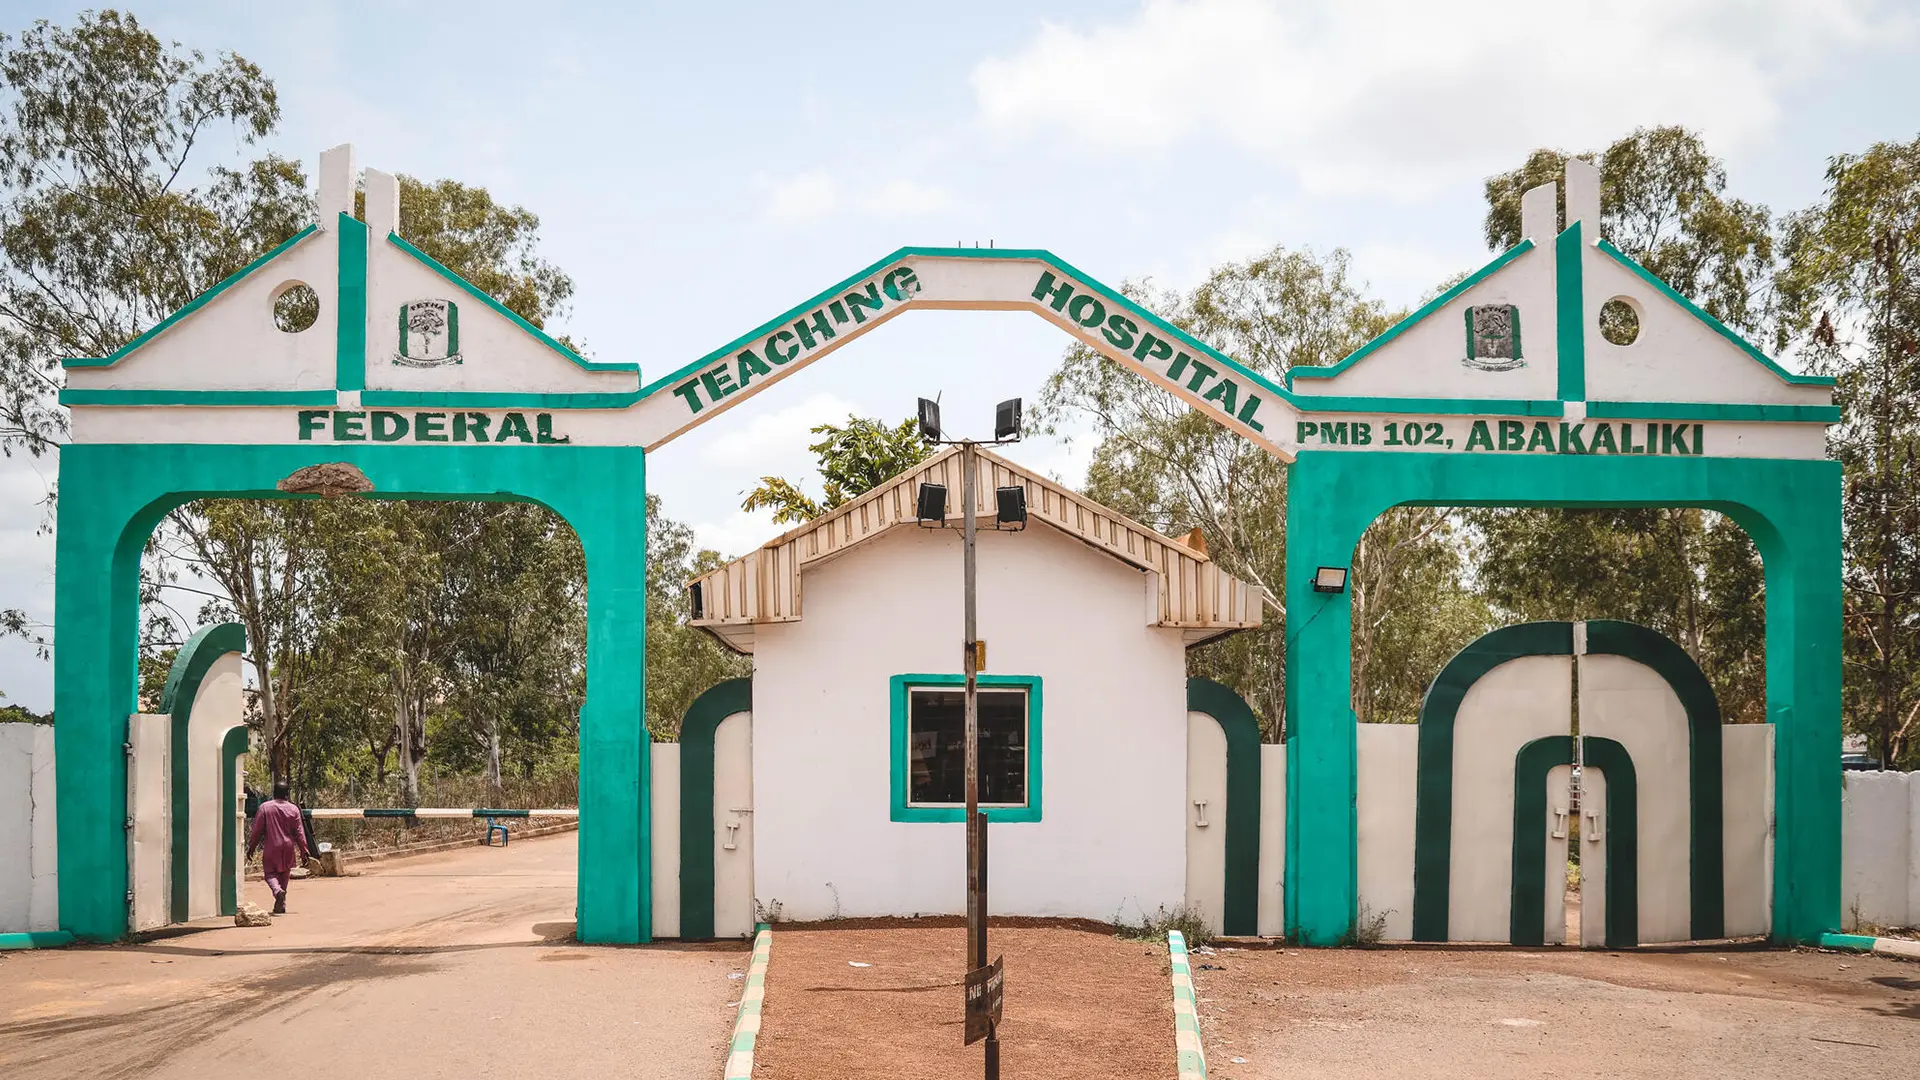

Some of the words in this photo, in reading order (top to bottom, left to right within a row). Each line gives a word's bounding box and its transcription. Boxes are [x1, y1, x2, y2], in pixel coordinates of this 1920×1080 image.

[410, 302, 444, 311] FETHA
[672, 266, 921, 414] TEACHING
[1031, 270, 1264, 432] HOSPITAL
[298, 410, 571, 444] FEDERAL
[1296, 421, 1372, 446] PMB
[1383, 422, 1453, 450] 102,
[1465, 419, 1704, 455] ABAKALIKI
